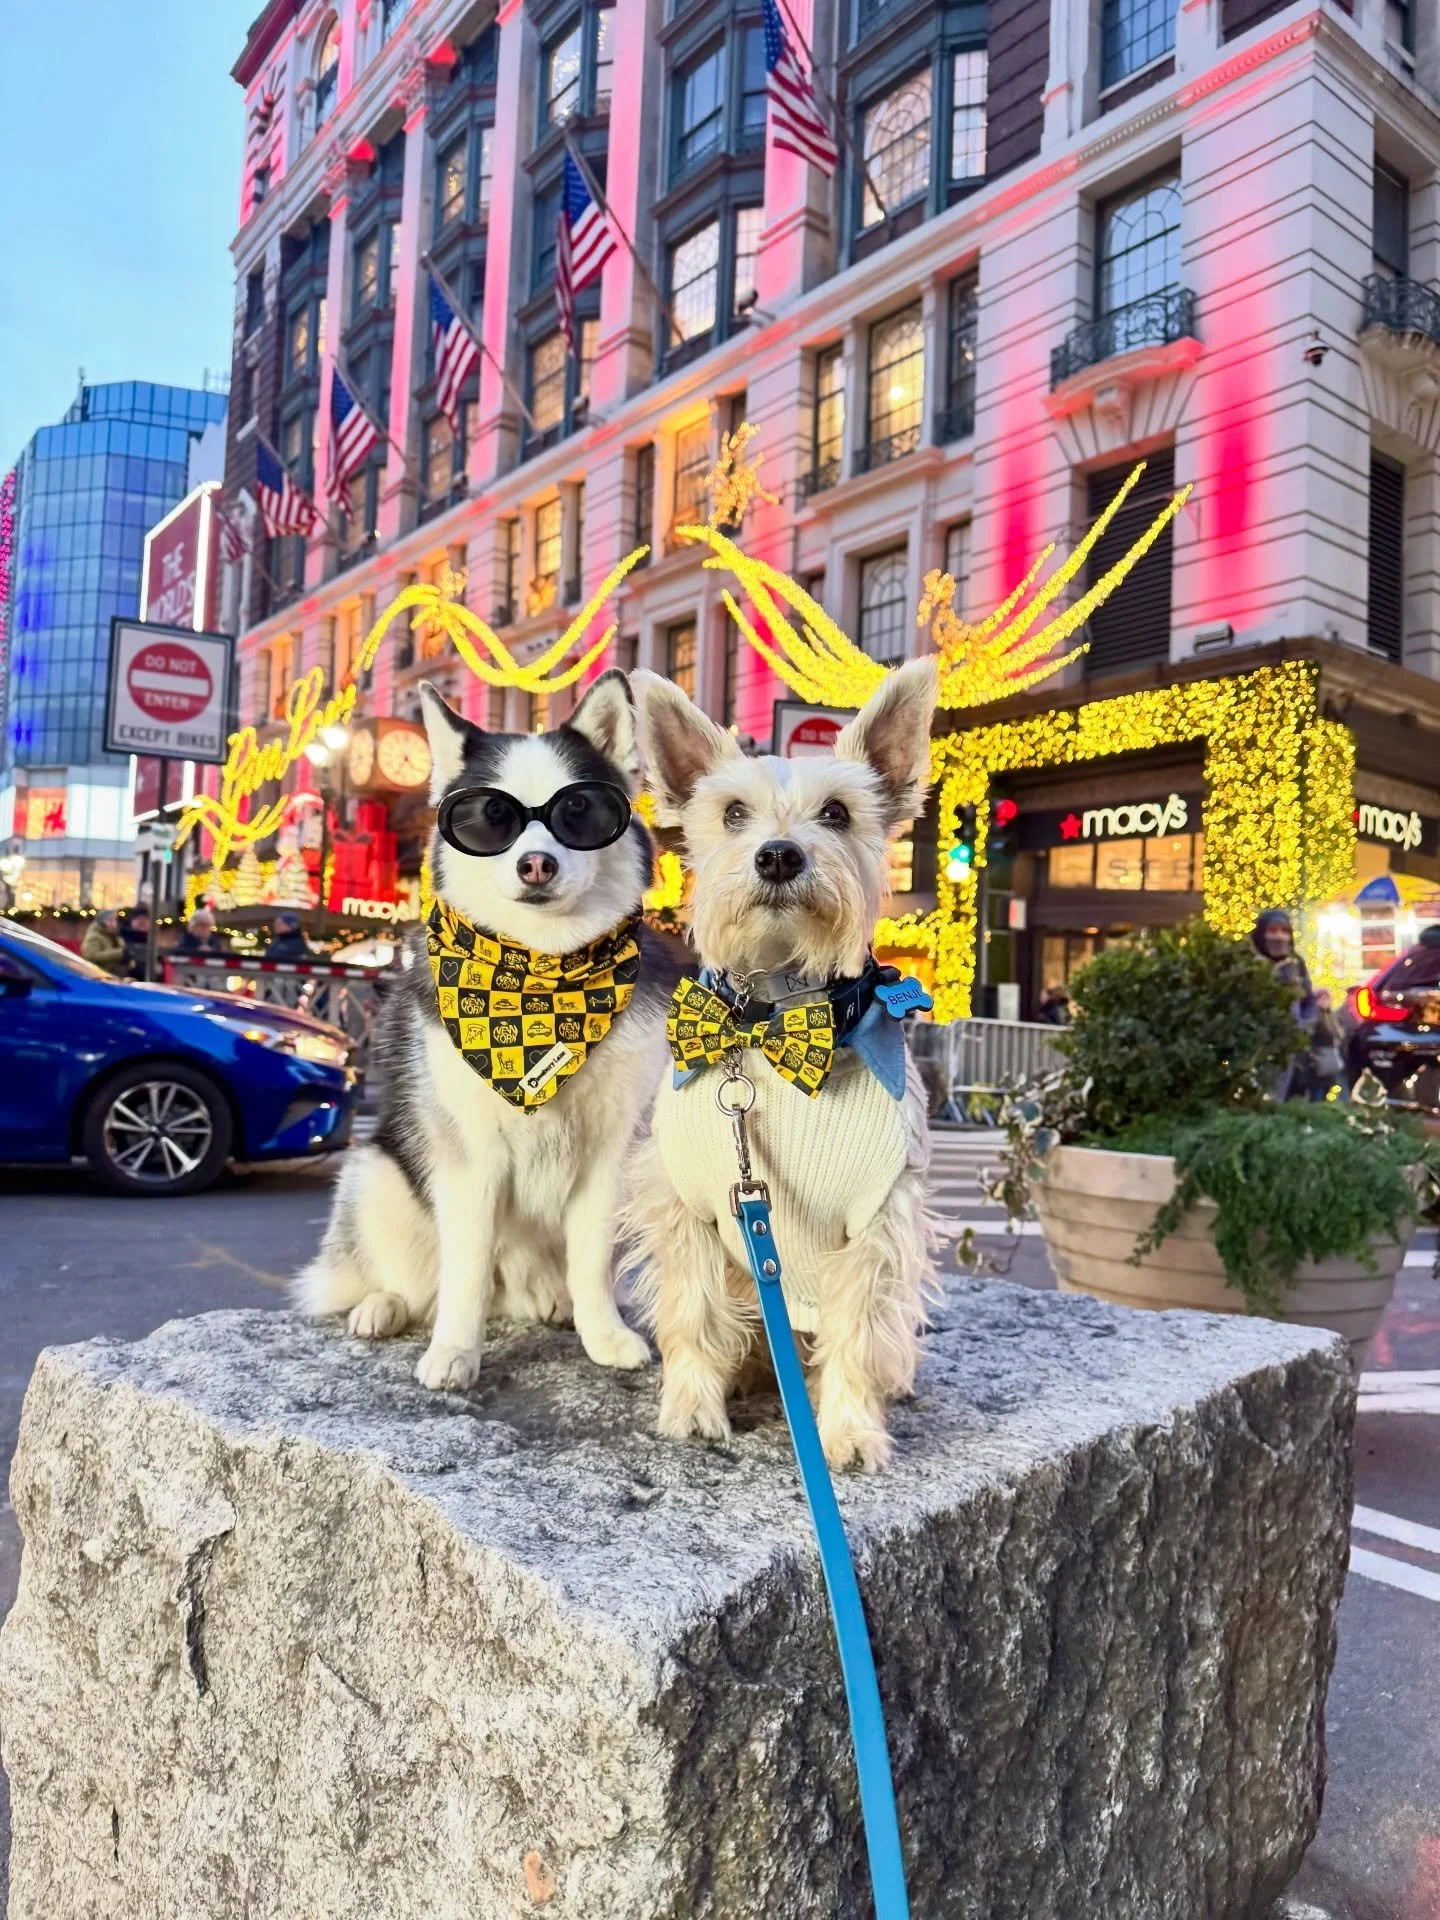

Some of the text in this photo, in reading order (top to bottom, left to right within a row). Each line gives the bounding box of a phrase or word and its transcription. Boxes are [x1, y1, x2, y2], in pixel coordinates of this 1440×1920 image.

[145, 655, 197, 674] DO NOT
[144, 691, 190, 711] ENTER
[119, 725, 217, 751] EXCEPT BIKES
[1082, 793, 1188, 838] macy's
[888, 989, 922, 1006] BENJI
